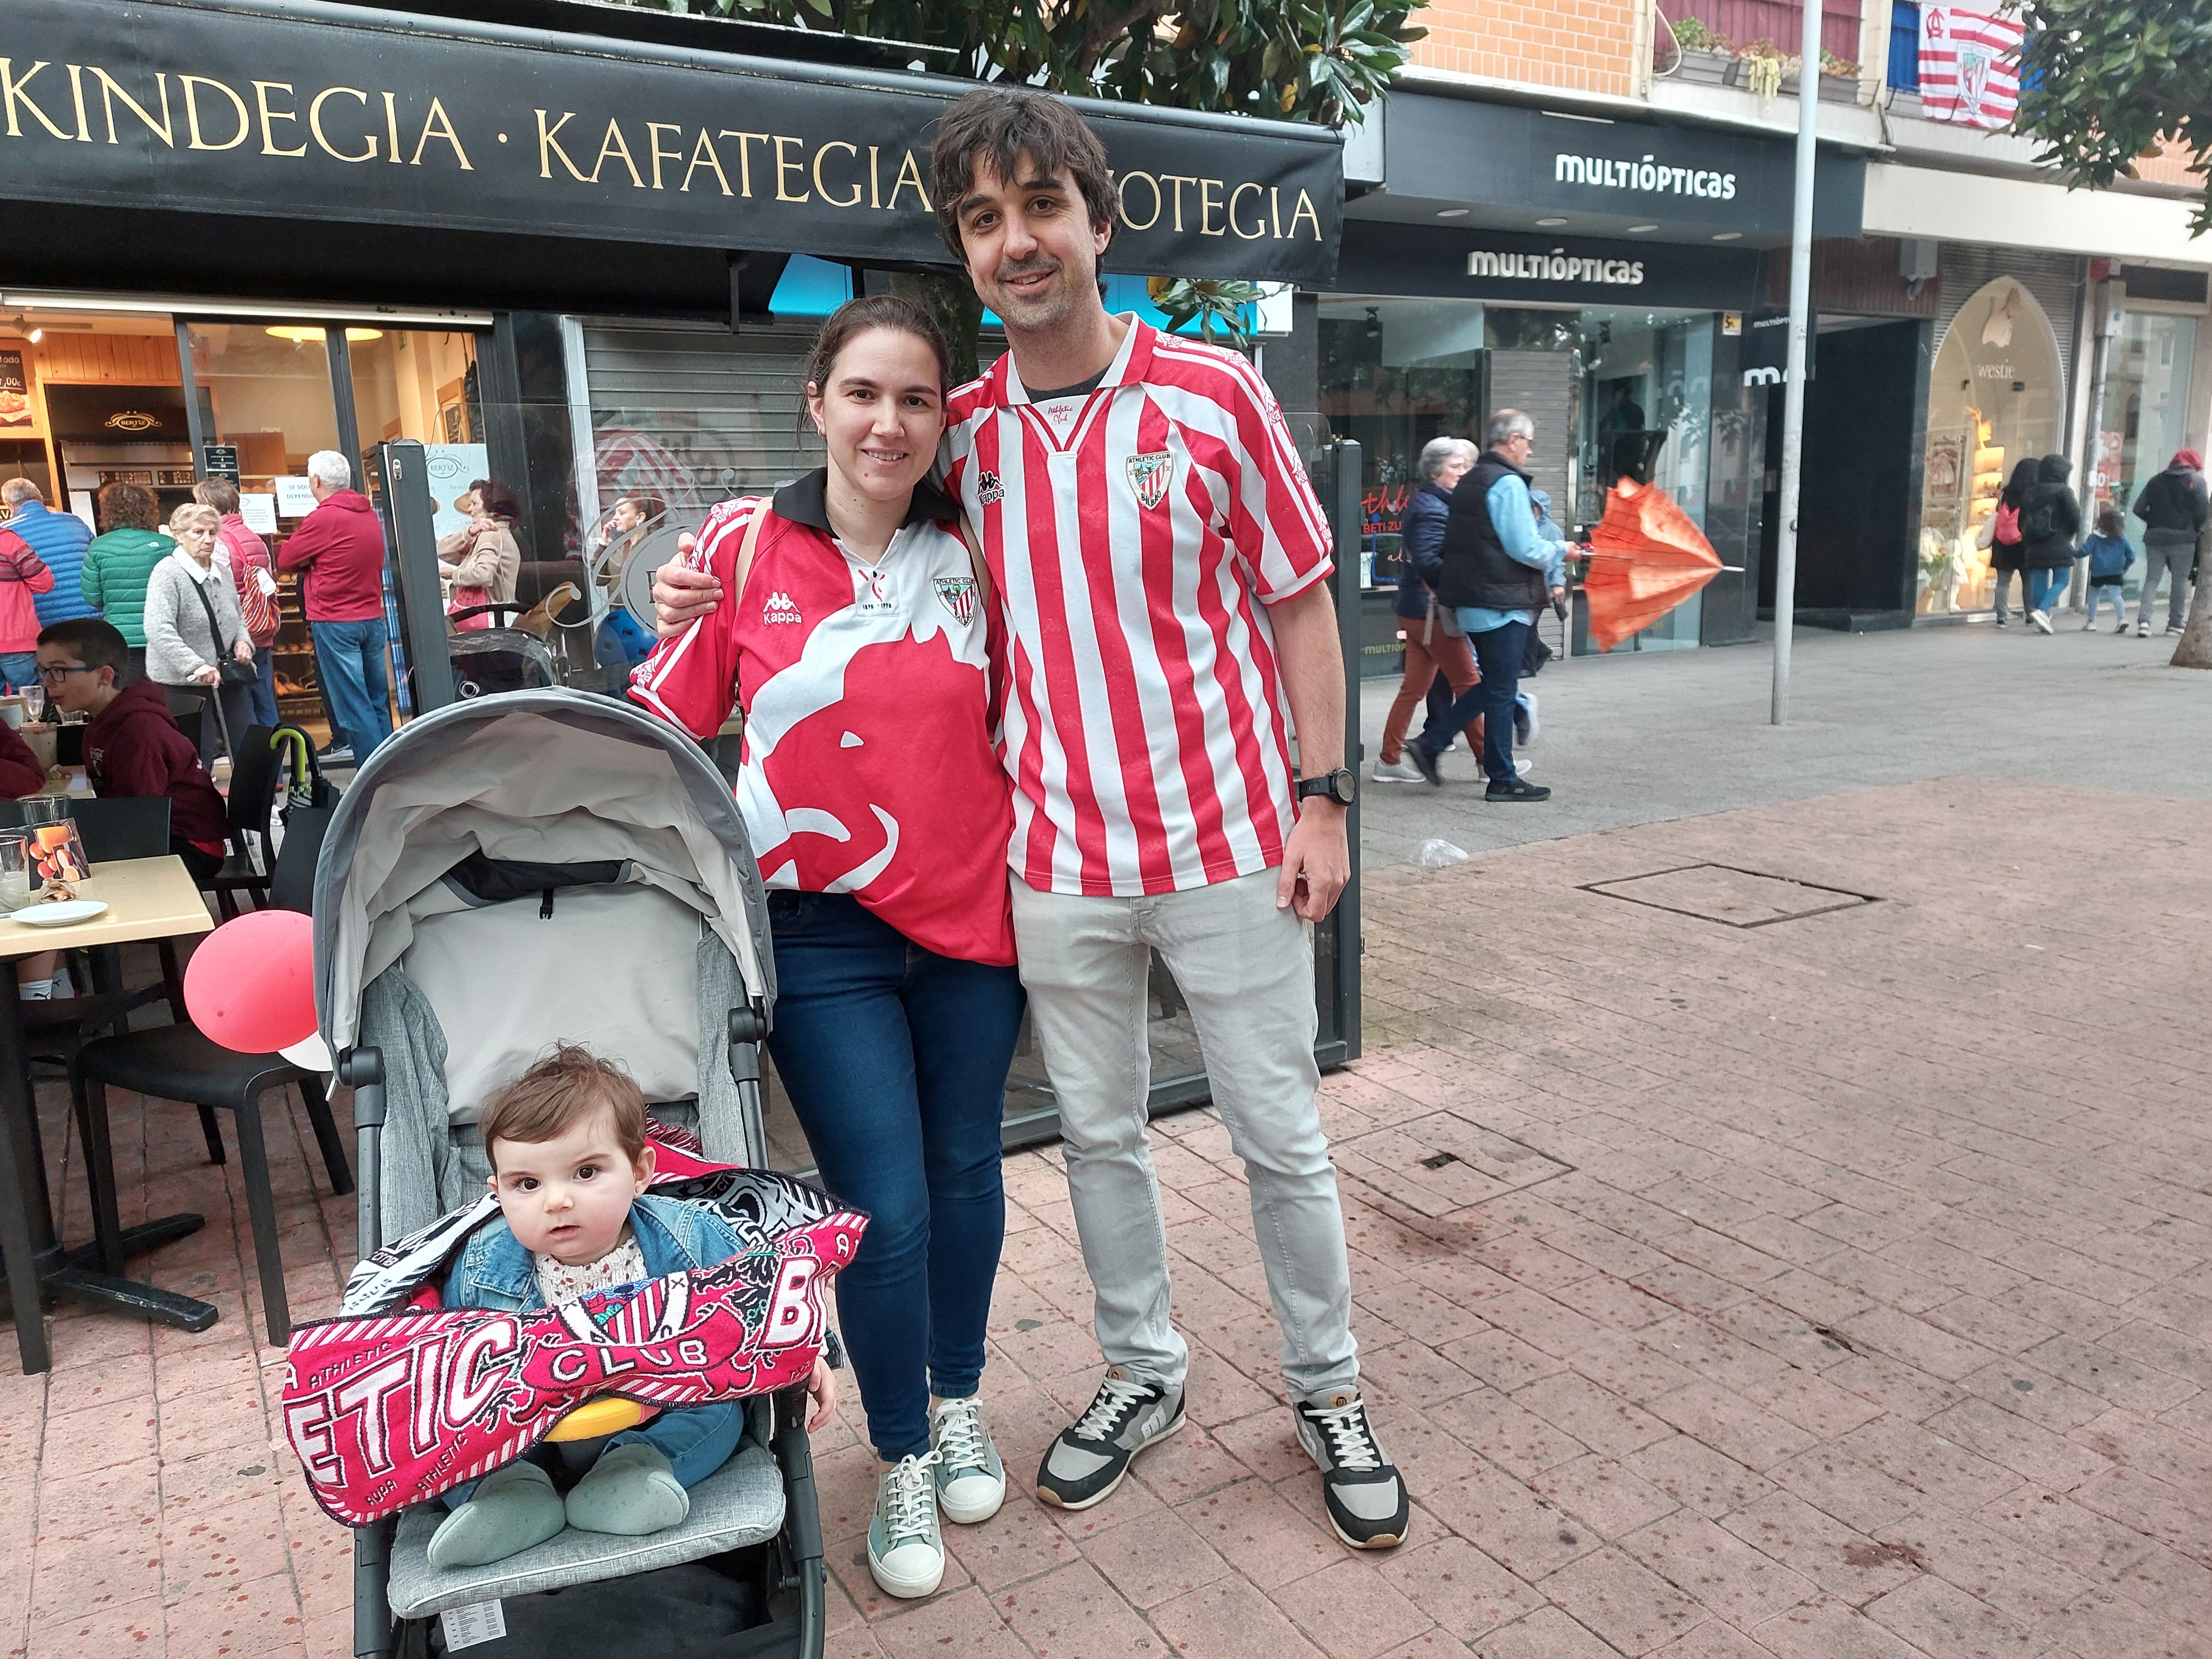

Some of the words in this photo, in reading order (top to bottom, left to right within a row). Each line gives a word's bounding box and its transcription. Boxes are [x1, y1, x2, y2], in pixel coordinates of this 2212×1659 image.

[0, 57, 475, 170] KINDEGIA
[534, 108, 934, 212] KAFATEGIA
[1106, 169, 1323, 242] OTEGIA
[1140, 490, 1161, 507] BILBAO
[1363, 522, 1386, 534] BETI
[763, 611, 802, 625] Kappa
[550, 1338, 708, 1383] CLUB
